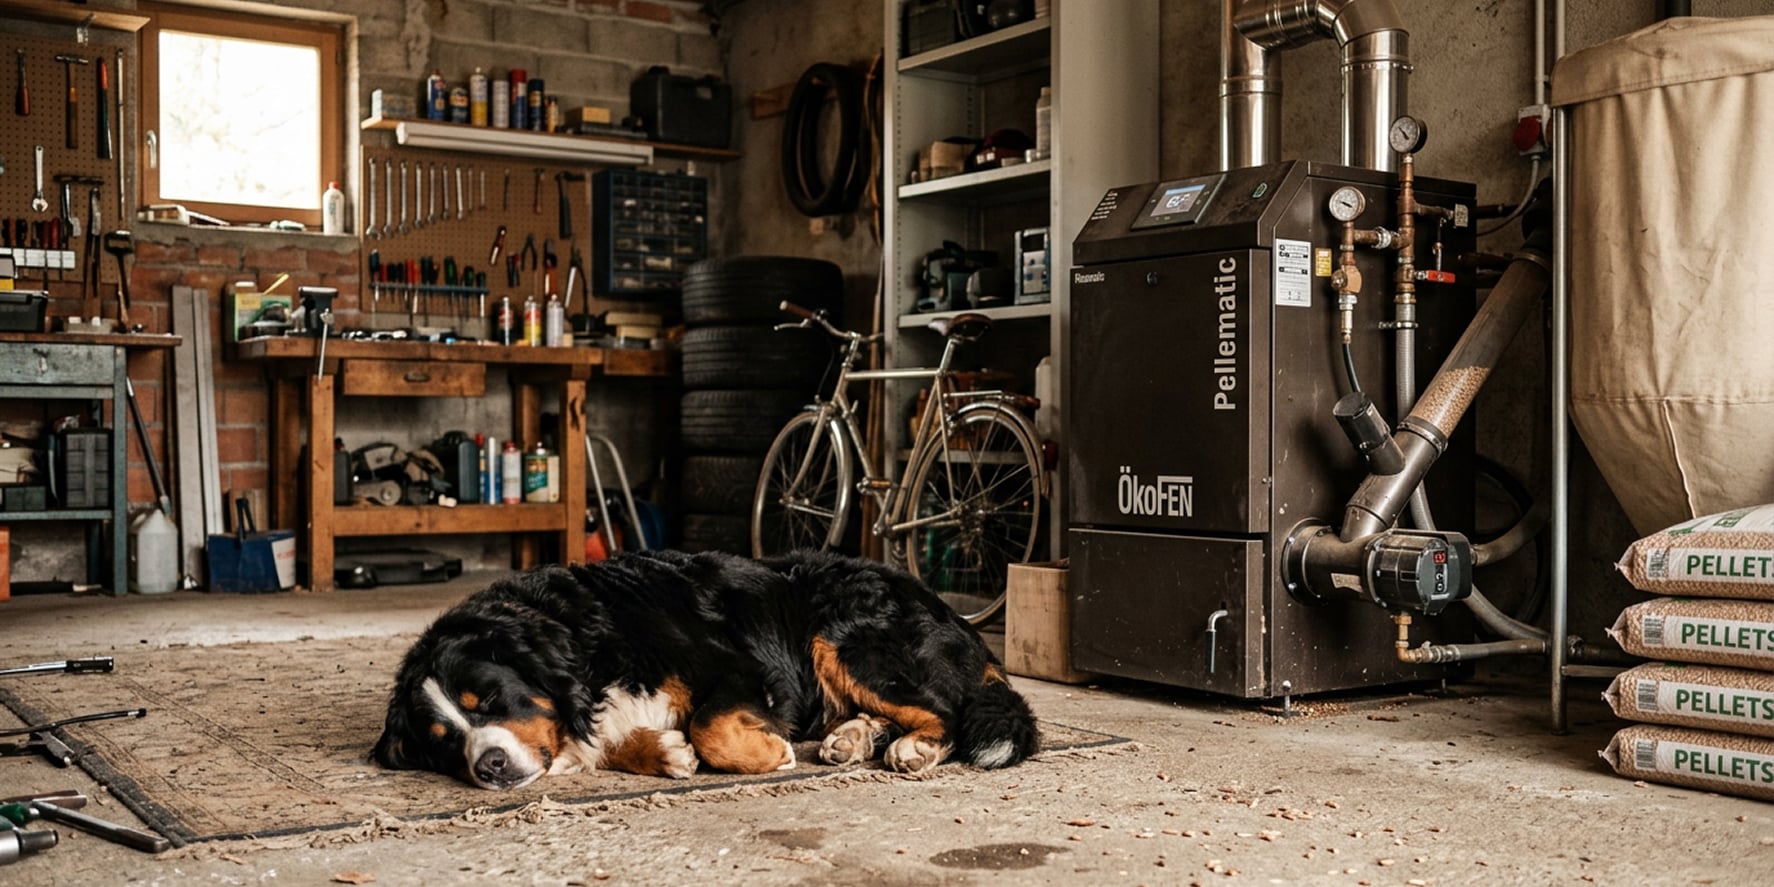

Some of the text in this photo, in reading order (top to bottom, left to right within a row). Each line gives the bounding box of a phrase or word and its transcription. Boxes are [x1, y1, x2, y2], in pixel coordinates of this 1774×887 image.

[1214, 257, 1236, 410] Pellematic
[1118, 465, 1193, 517] ÖkoFEN
[1687, 554, 1774, 578] PELLET
[1676, 689, 1774, 720] PELLETS
[1675, 749, 1774, 783] PELLETS
